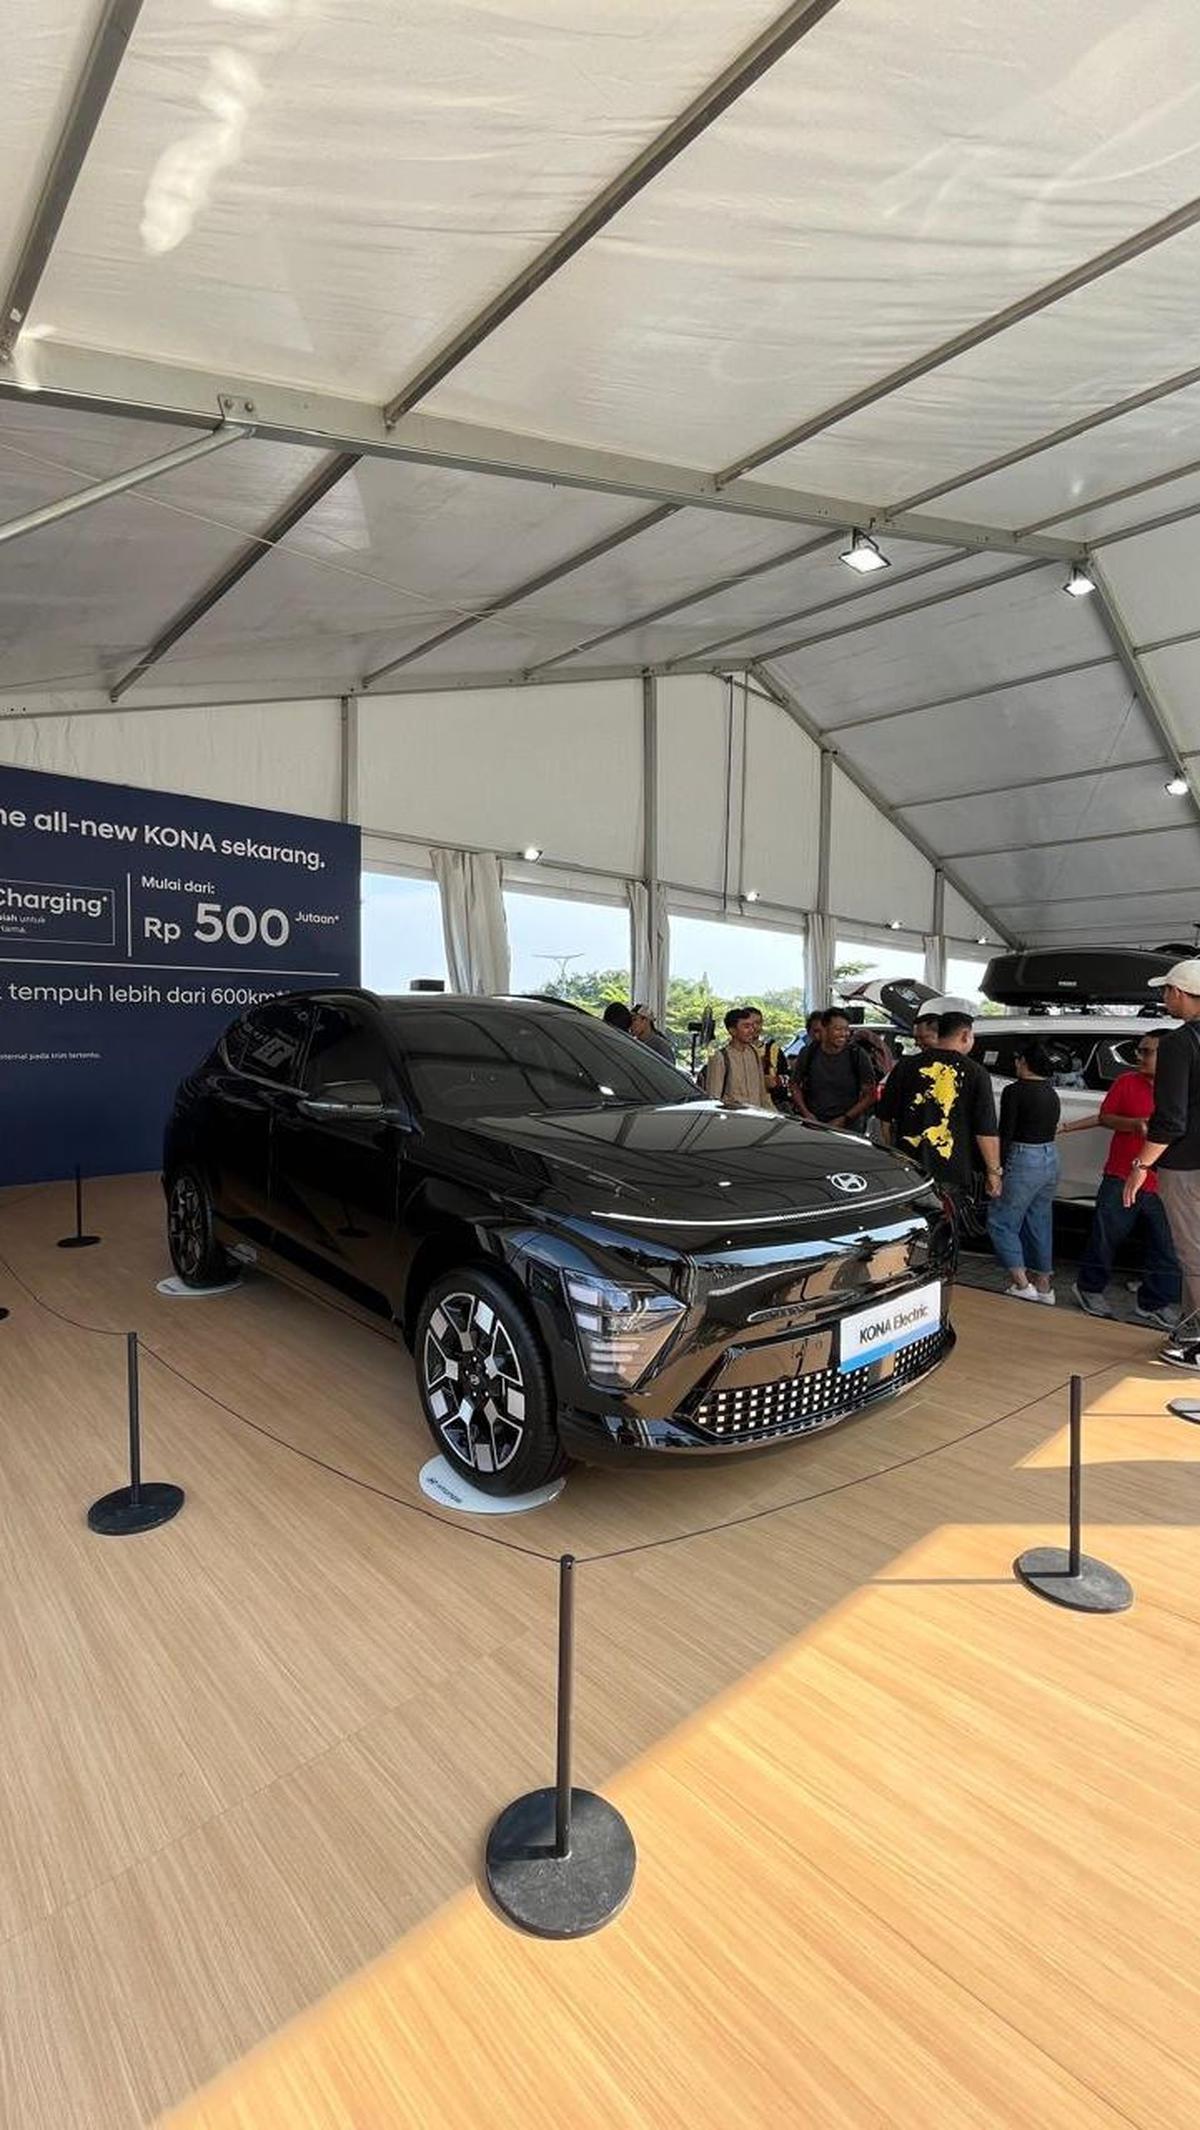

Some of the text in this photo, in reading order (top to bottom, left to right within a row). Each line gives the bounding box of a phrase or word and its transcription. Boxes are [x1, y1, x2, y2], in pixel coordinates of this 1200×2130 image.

[33, 811, 138, 842] all-new
[144, 825, 217, 853] KONA
[220, 838, 326, 871] sekarang.
[141, 875, 215, 895] Mulai dari:
[144, 916, 181, 944] Rp
[194, 902, 290, 947] 500
[7, 982, 103, 1005] tempuh
[109, 984, 161, 1004] lebih
[166, 986, 206, 1004] dari
[859, 1303, 929, 1344] KONA Electric
